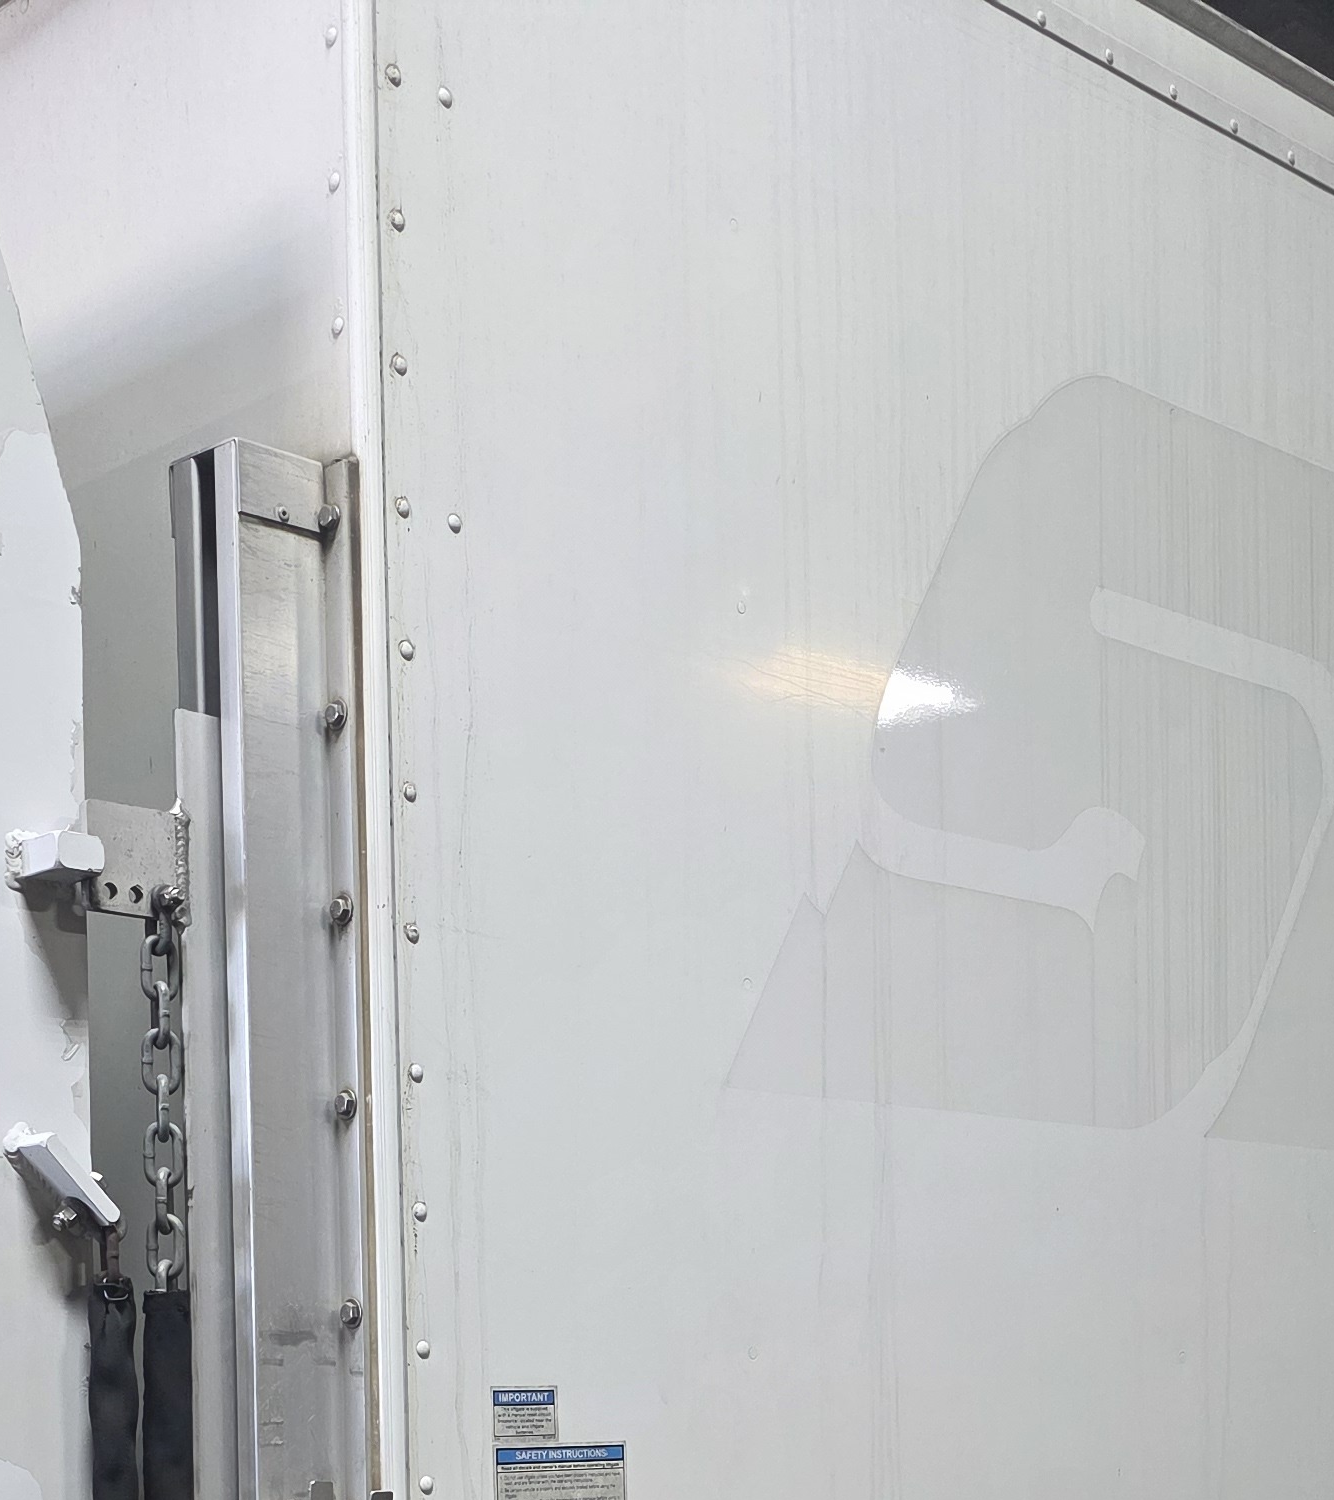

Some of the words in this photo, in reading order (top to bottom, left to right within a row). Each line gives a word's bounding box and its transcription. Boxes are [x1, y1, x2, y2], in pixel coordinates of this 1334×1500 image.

[499, 1393, 548, 1402] IMPORTANT
[516, 1450, 547, 1460] SAFETY
[549, 1449, 608, 1459] INSTRUCTIONS
